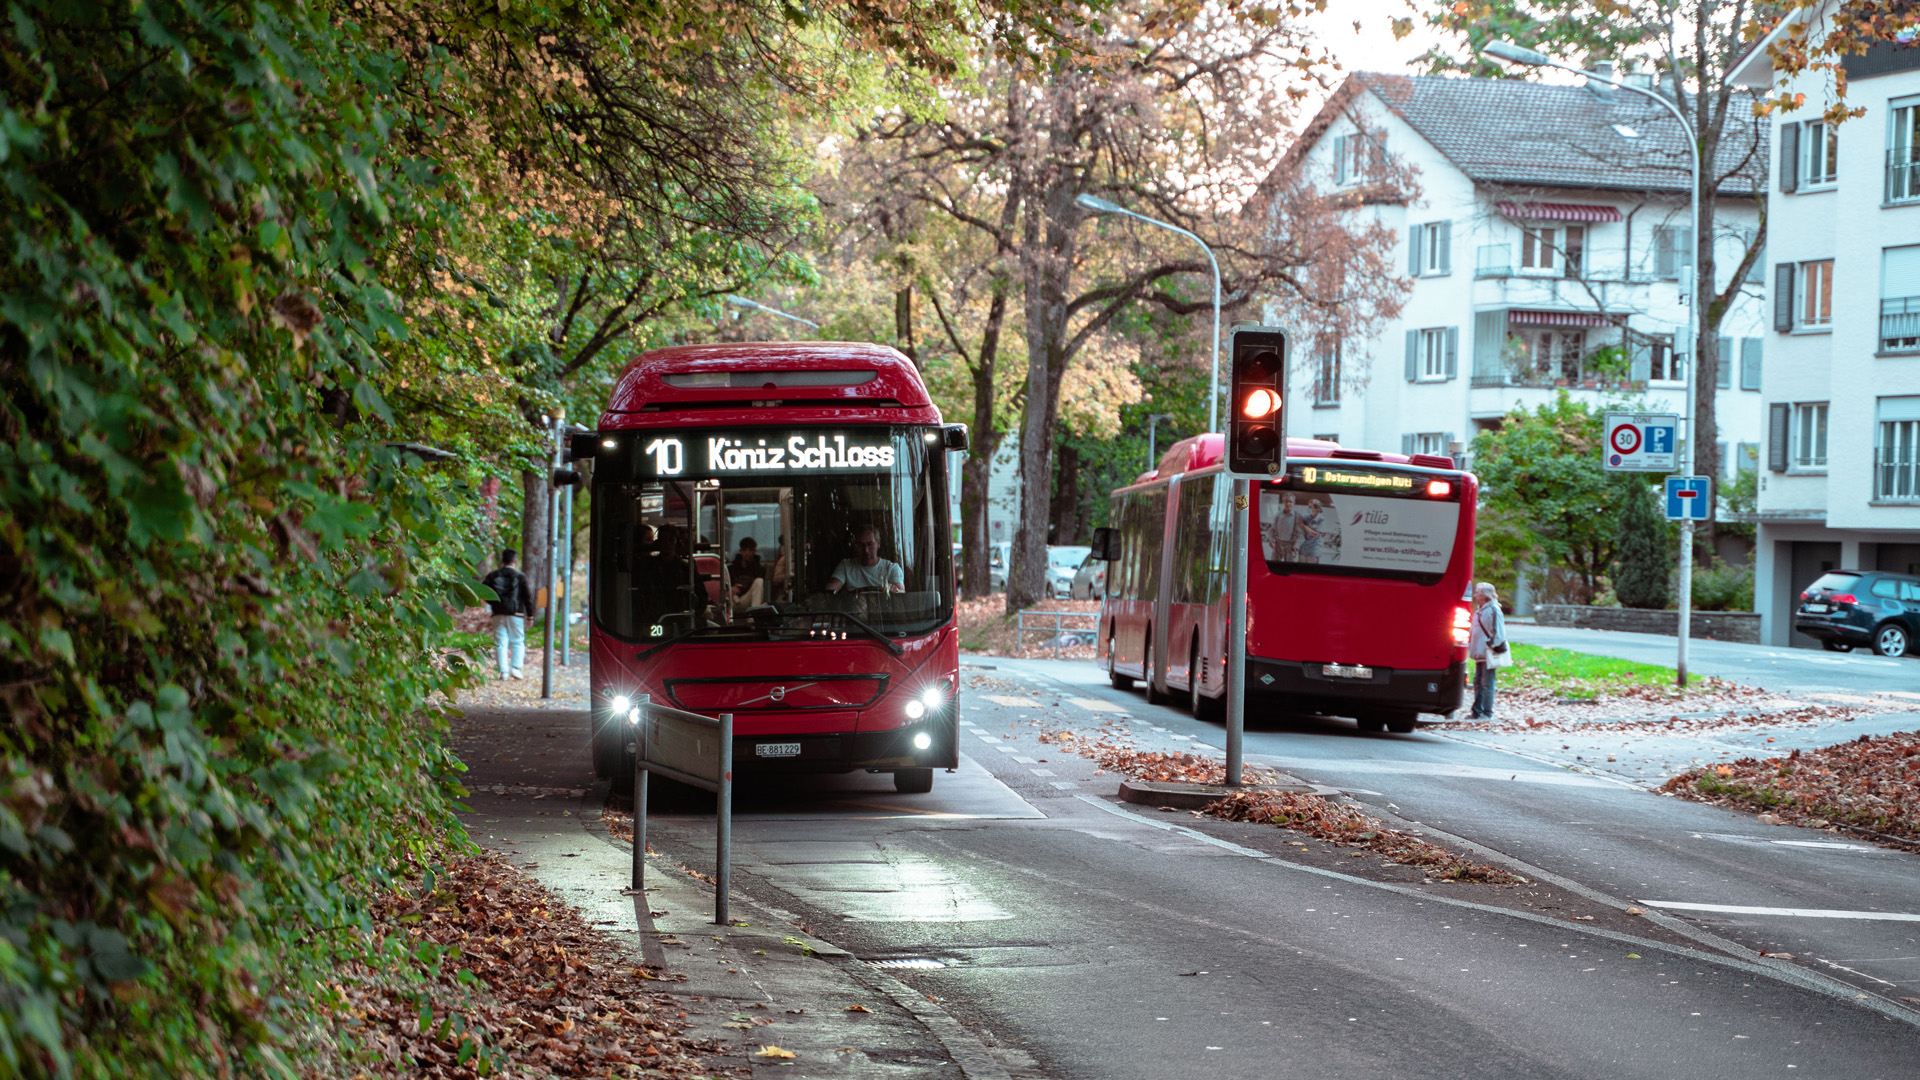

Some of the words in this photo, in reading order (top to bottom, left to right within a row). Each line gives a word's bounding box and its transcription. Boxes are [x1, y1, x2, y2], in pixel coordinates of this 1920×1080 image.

[1632, 416, 1652, 424] ZONE
[1619, 433, 1633, 445] 30
[1653, 428, 1667, 442] P
[645, 438, 683, 475] 10
[708, 437, 786, 470] Köniz
[787, 435, 895, 468] Schloss
[1302, 467, 1317, 484] 10
[1324, 471, 1392, 486] Ostermundigen
[1364, 510, 1389, 525] tilia
[1362, 546, 1442, 558] www.tilia-stiftung.ch
[650, 624, 663, 637] 20
